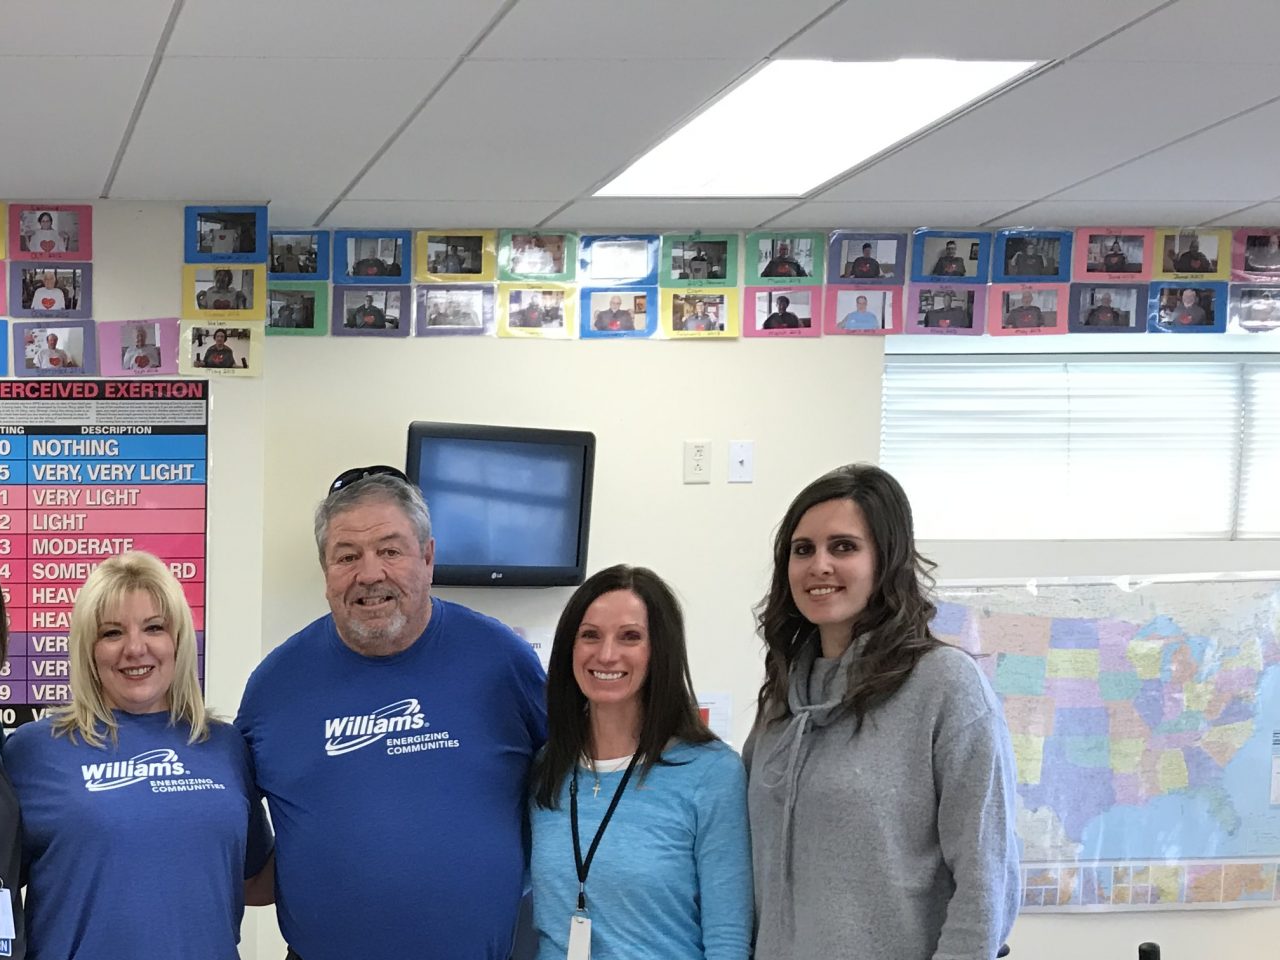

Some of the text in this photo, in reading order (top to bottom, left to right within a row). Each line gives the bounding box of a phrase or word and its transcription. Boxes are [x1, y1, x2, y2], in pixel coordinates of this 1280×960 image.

[105, 382, 203, 398] EXERTION
[81, 426, 152, 435] DESCRIPTION
[32, 440, 120, 457] NOTHING
[32, 464, 195, 484] VERY, VERY LIGHT
[0, 489, 9, 506] 1
[32, 489, 140, 506] VERY LIGHT
[32, 514, 87, 531] LIGHT
[32, 539, 133, 556] MODERATE
[387, 731, 450, 746] ENERGIZING
[387, 739, 460, 756] COMMUNITIES
[150, 778, 214, 787] ENERGIZING
[151, 783, 226, 793] COMMUNITIES
